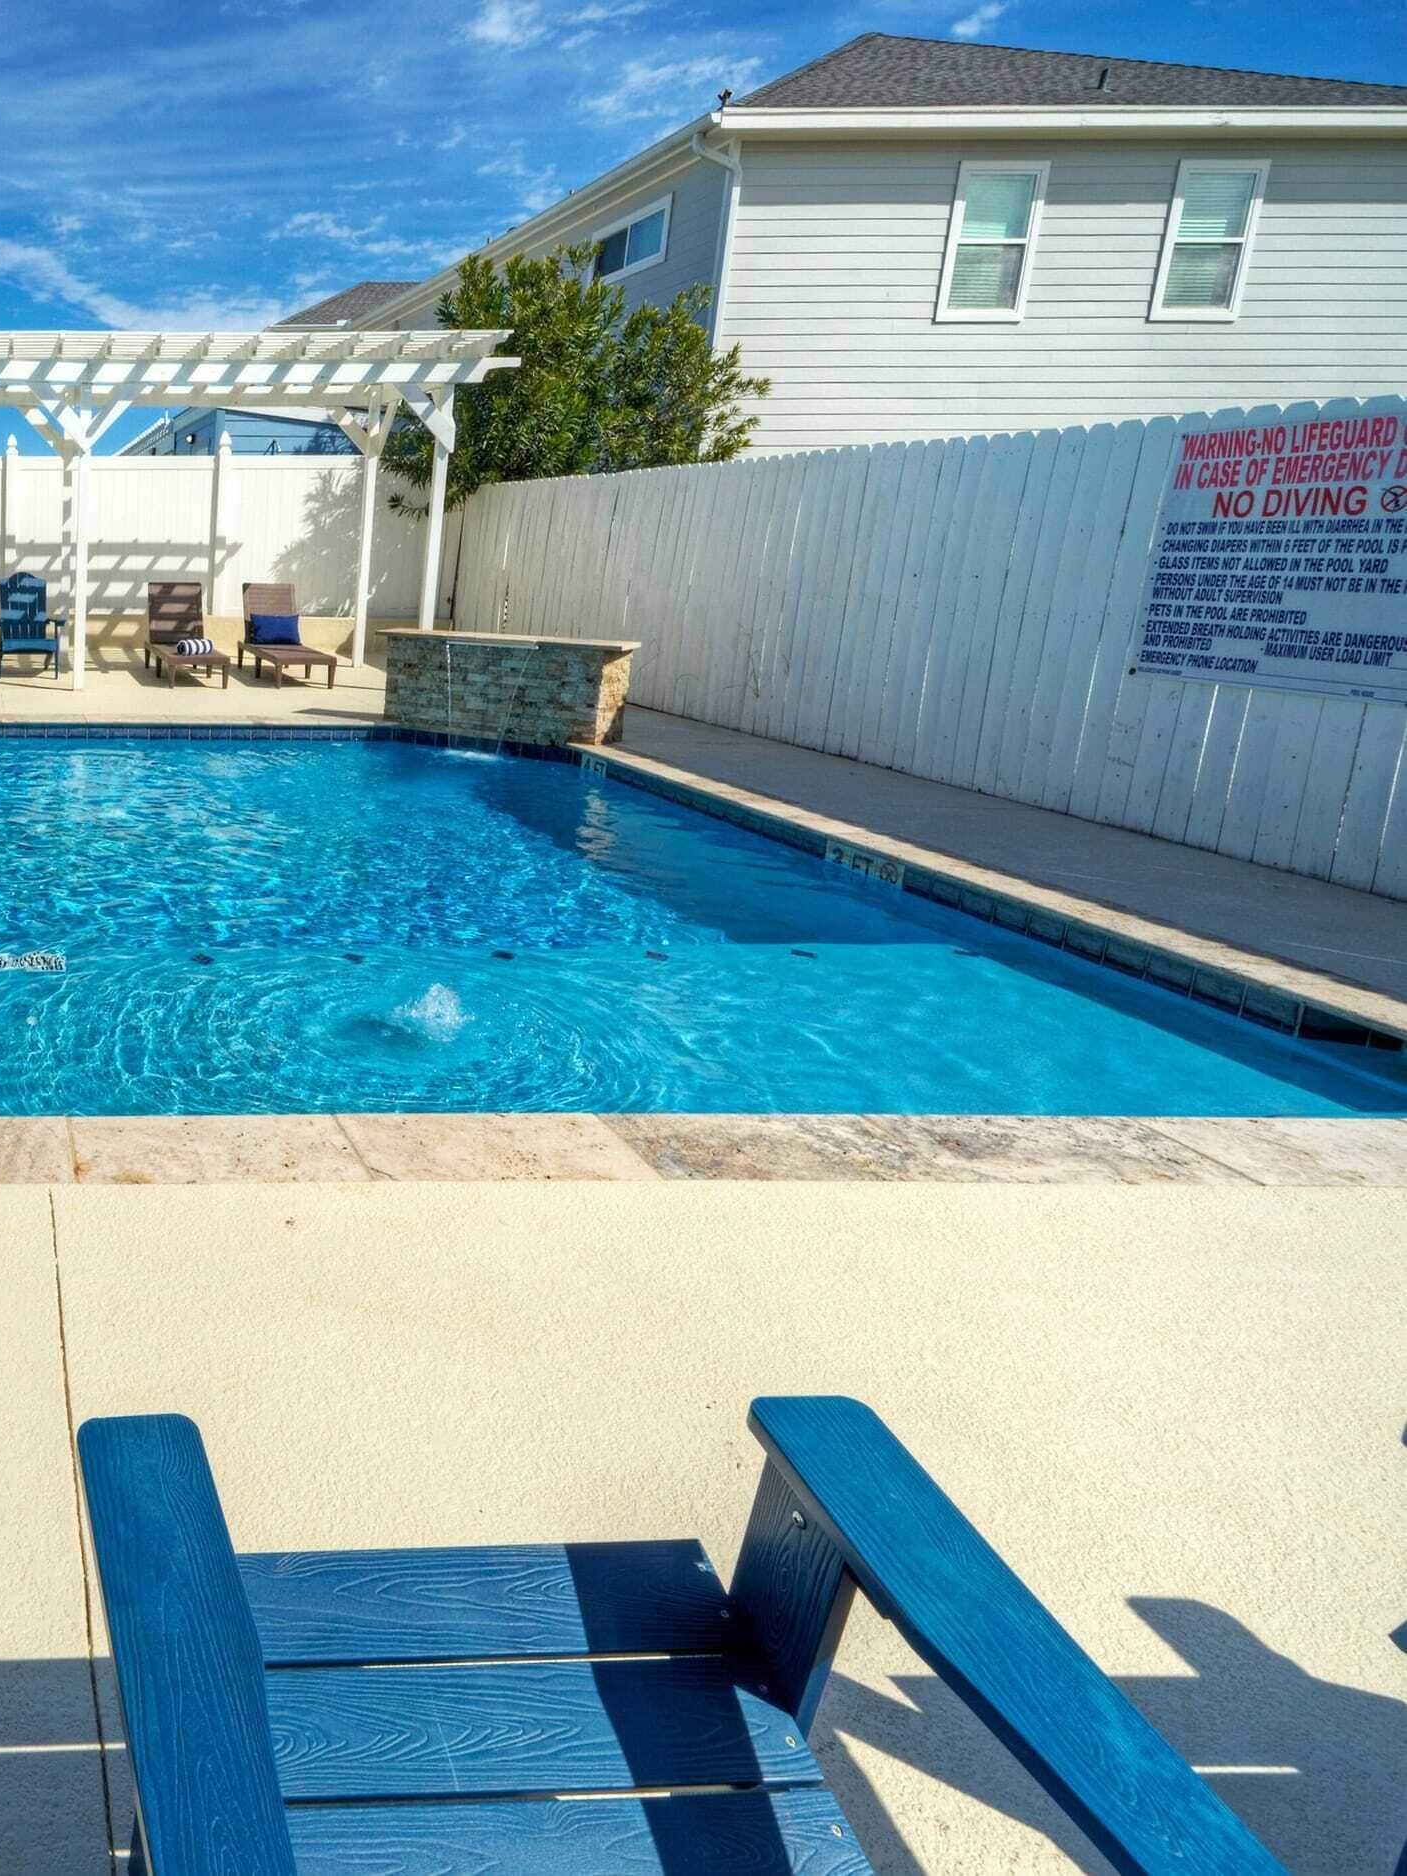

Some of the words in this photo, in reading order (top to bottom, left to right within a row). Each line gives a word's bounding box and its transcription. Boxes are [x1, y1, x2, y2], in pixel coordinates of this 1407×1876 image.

[1290, 416, 1398, 453] LIFEGUARD
[1174, 463, 1195, 490] IN
[1197, 460, 1243, 489] CASE
[1246, 458, 1270, 486] OF
[1272, 449, 1394, 486] EMERGENCY
[1212, 490, 1254, 518] NO
[1261, 485, 1368, 518] DIVING
[1180, 522, 1197, 535] NOT
[1196, 521, 1218, 535] SWIM
[1218, 521, 1227, 534] IF
[1228, 521, 1244, 534] YOU
[1244, 520, 1266, 534] HAVE
[1265, 520, 1288, 534] BEEN
[1288, 520, 1300, 534] ILL
[1302, 519, 1325, 534] WITH
[1325, 519, 1370, 534] DIARRHEA
[1370, 519, 1383, 534] IN
[1385, 519, 1404, 533] THE
[1162, 539, 1210, 553] CHANGING
[1211, 540, 1248, 553] DIAPERS
[1249, 540, 1282, 553] WITHIN
[1284, 539, 1291, 553] 6
[1292, 539, 1317, 553] FEET
[1318, 539, 1332, 553] OF
[1333, 539, 1355, 553] THE
[1356, 539, 1384, 554] POOL
[1387, 539, 1399, 554] IS
[1158, 556, 1191, 570] GLASS
[1192, 557, 1220, 570] ITEMS
[1220, 557, 1242, 570] NOT
[1242, 557, 1288, 571] ALLOWED
[1289, 558, 1302, 571] IN
[1303, 558, 1325, 572] THE
[1325, 558, 1354, 573] POOL
[1358, 558, 1389, 573] YARD
[1154, 573, 1197, 587] PERSONS
[1197, 573, 1227, 588] UNDER
[1228, 574, 1247, 589] THE
[1247, 575, 1267, 589] AGE
[1268, 575, 1282, 590] OF
[1283, 576, 1294, 590] 14
[1295, 576, 1324, 591] MUST
[1324, 576, 1346, 592] NOT
[1348, 577, 1363, 593] BE
[1364, 578, 1378, 593] IN
[1379, 578, 1403, 594] THE
[1152, 587, 1194, 601] WITHOUT
[1194, 588, 1224, 602] ADULT
[1223, 589, 1284, 605] SUPERVISION
[1148, 603, 1173, 618] PETS
[1173, 605, 1185, 618] IN
[1185, 605, 1205, 619] THE
[1204, 606, 1228, 620] POOL
[1229, 607, 1250, 622] ARE
[1249, 608, 1307, 625] PROHIBITED
[1143, 634, 1162, 647] AND
[1161, 635, 1213, 651] PROHIBITED
[1146, 620, 1191, 635] EXTENDED
[1191, 622, 1227, 638] BREATH
[1226, 624, 1267, 640] HOLDING
[1268, 628, 1321, 645] ACTIVITIES
[1321, 631, 1343, 647] ARE
[1139, 650, 1187, 666] EMERGENCY
[1186, 654, 1216, 669] PHONE
[1214, 657, 1258, 673] LOCATION
[1264, 642, 1308, 659] MAXIMUM
[1308, 646, 1335, 662] USER
[1335, 648, 1362, 665] LOAD
[1363, 650, 1394, 667] LIMIT
[832, 847, 844, 865] 2
[851, 853, 874, 876] FT
